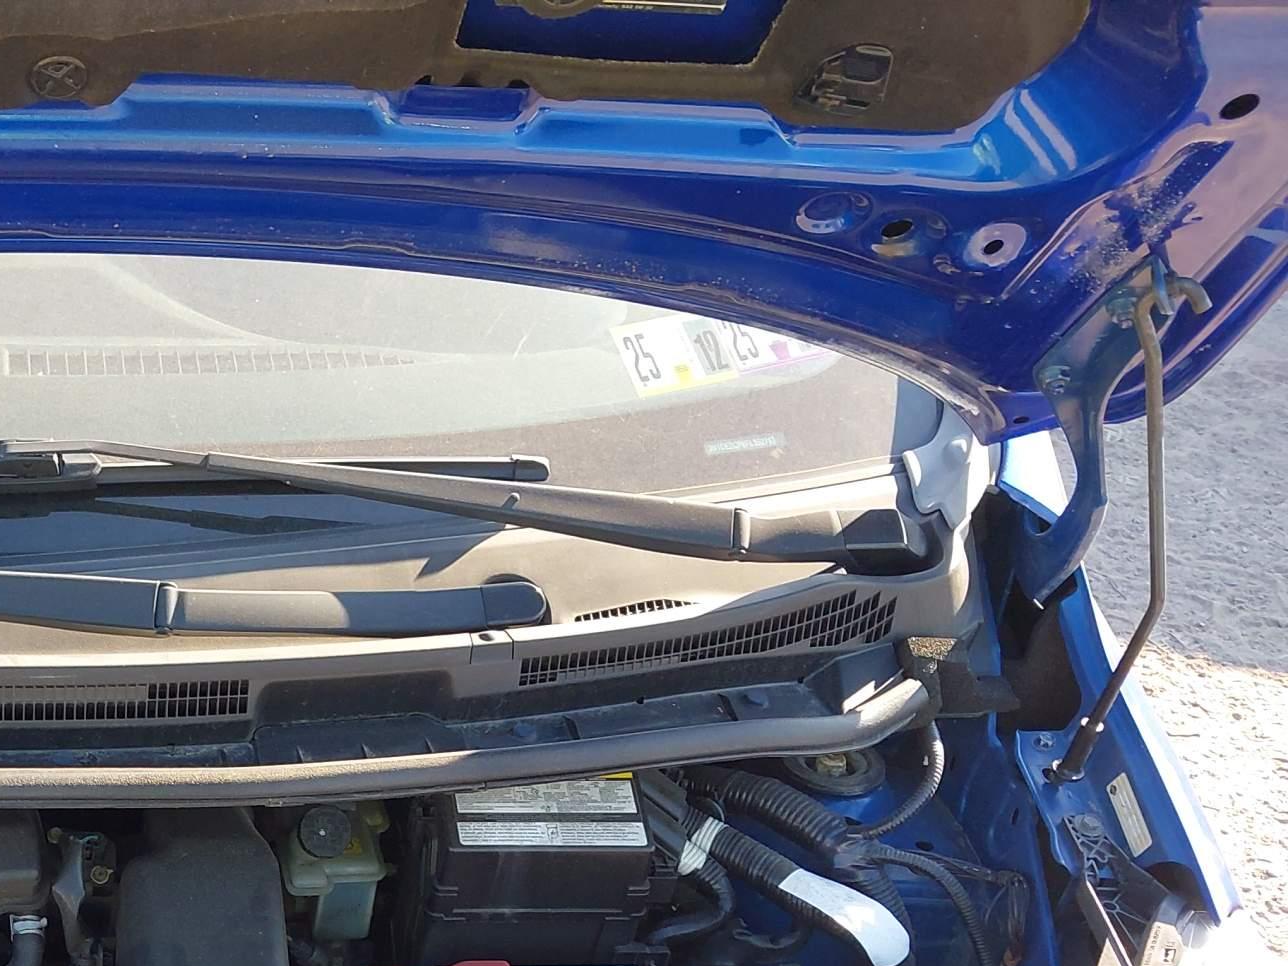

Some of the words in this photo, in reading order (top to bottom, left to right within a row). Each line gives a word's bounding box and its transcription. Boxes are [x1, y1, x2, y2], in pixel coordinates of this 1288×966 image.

[623, 334, 662, 383] 25
[694, 330, 729, 372] 12
[723, 322, 760, 362] 25
